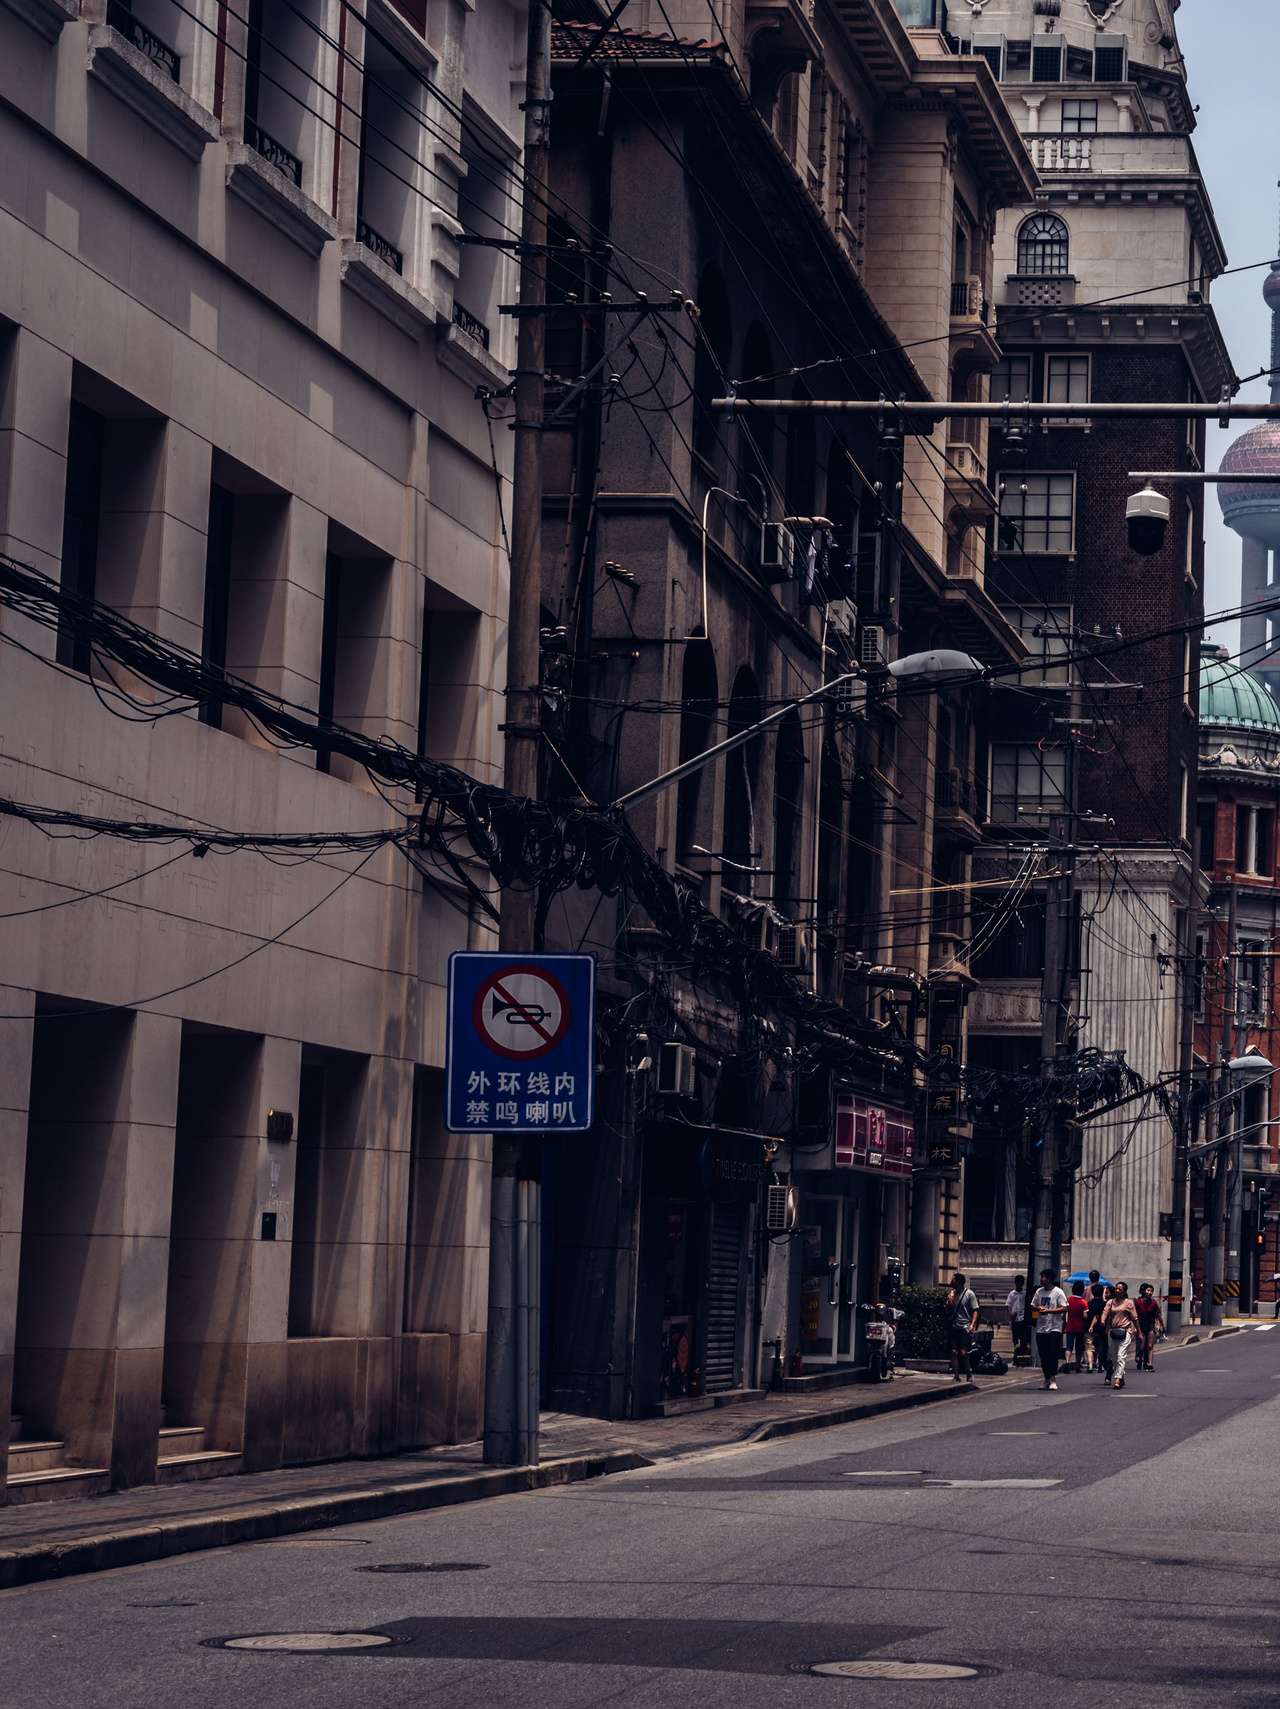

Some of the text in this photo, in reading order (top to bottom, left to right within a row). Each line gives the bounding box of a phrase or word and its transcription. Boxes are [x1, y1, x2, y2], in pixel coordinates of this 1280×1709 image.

[467, 1071, 575, 1096] 外环线内
[466, 1100, 576, 1124] 禁鸣喇叭
